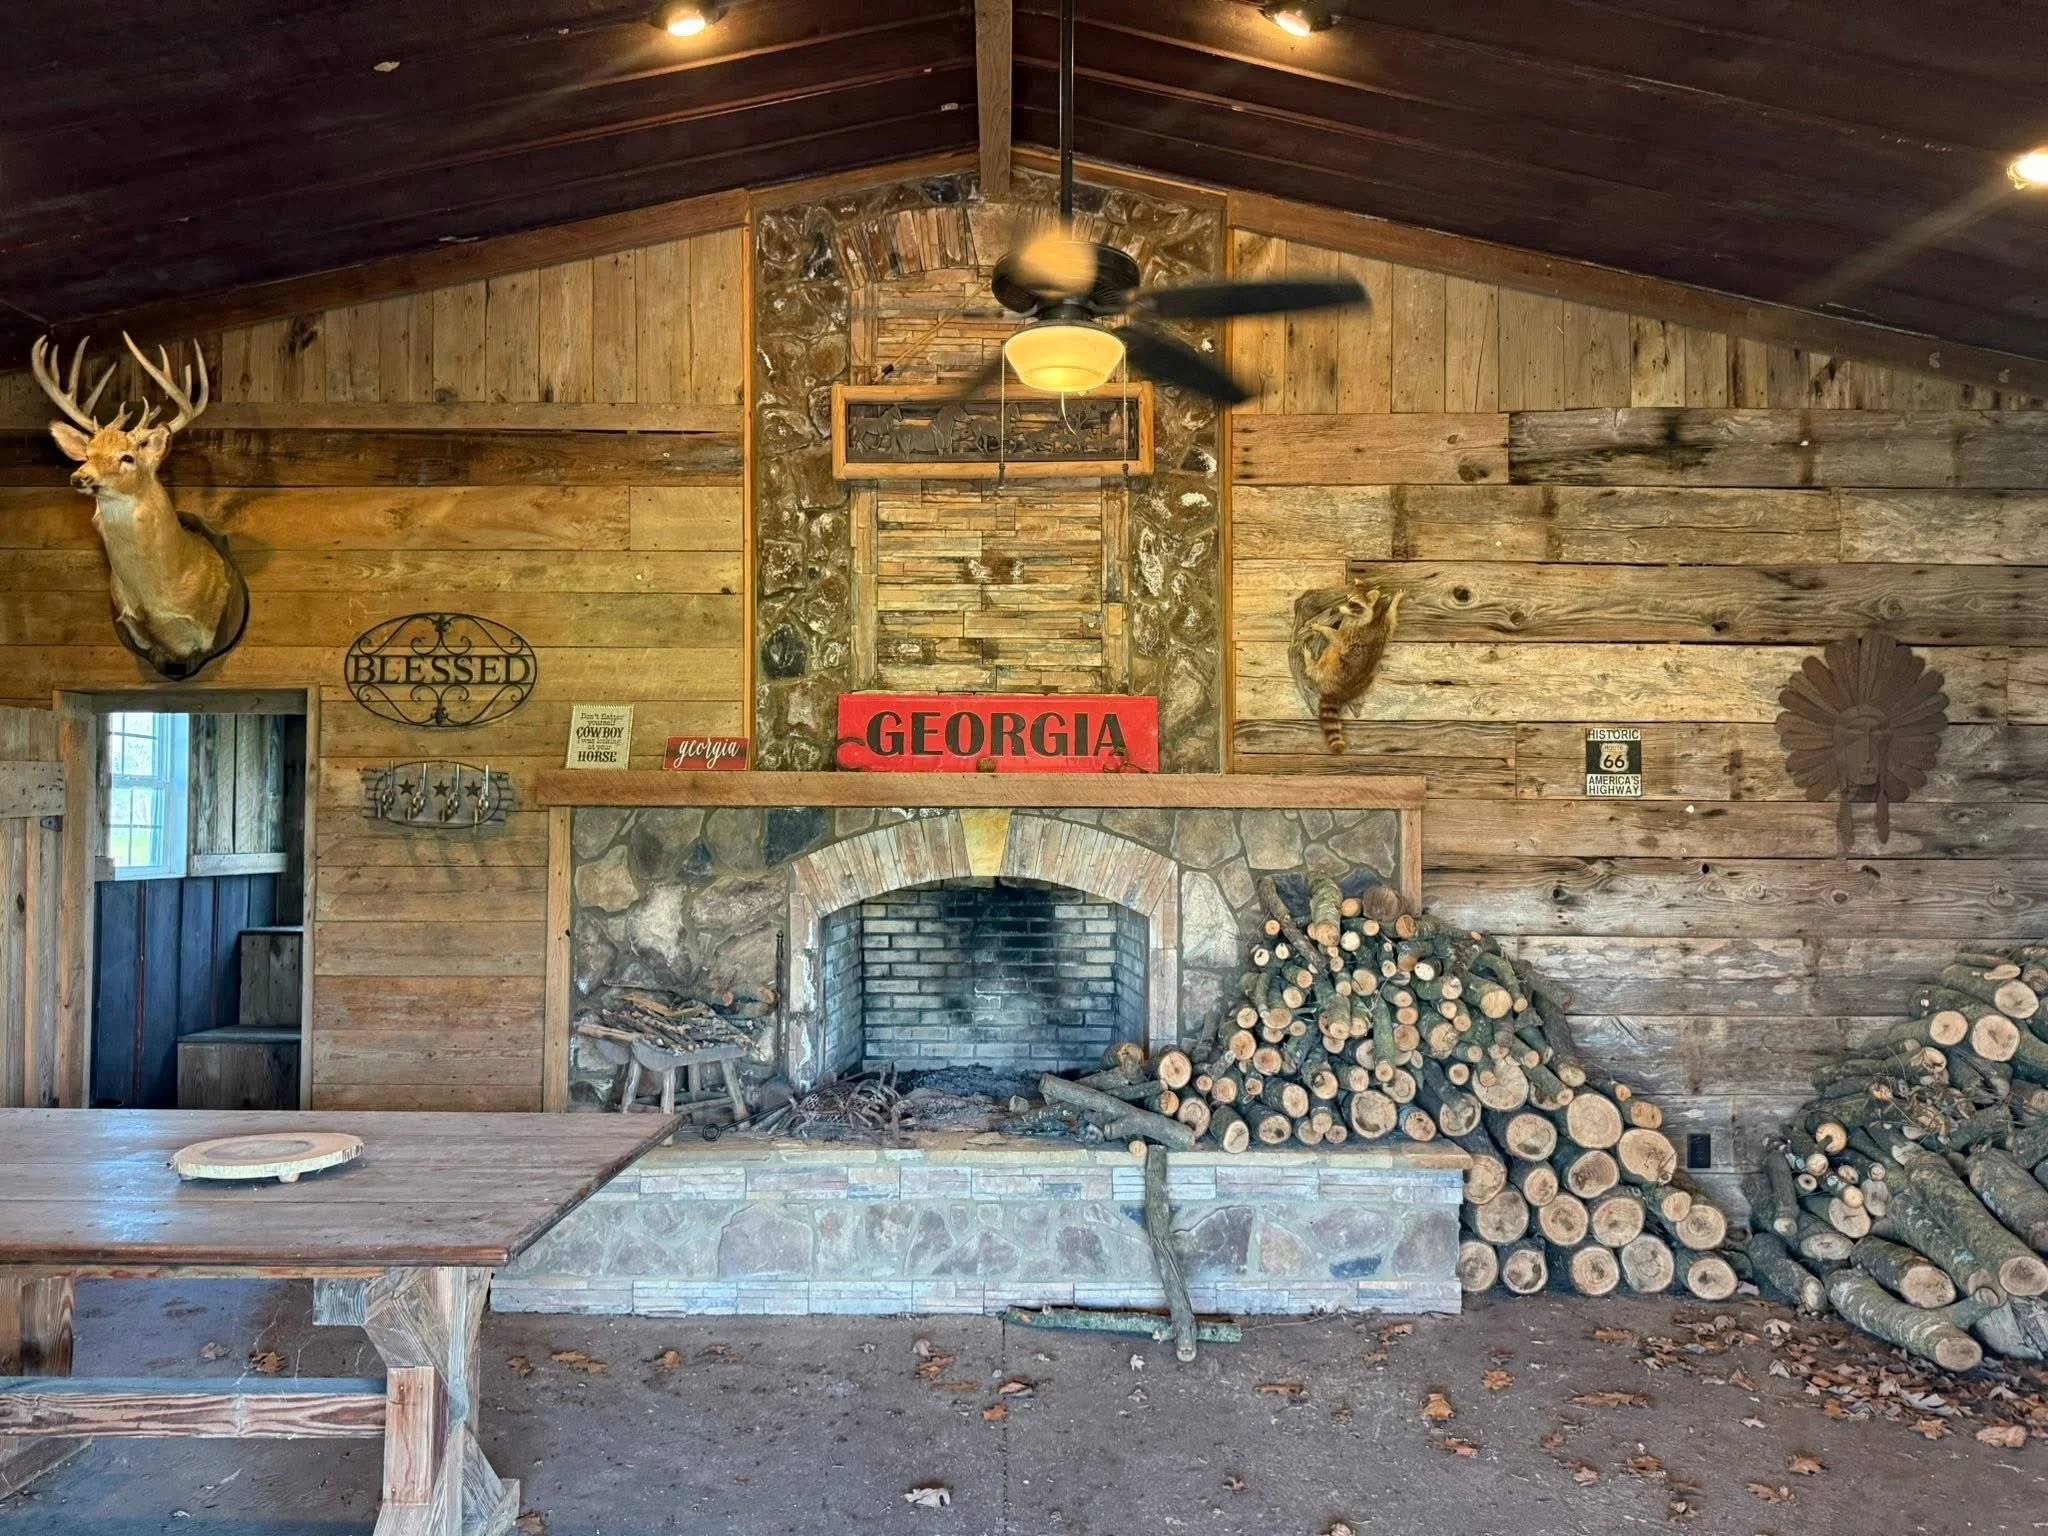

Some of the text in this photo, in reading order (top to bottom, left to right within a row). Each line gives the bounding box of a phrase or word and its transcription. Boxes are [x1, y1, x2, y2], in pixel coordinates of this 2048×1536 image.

[352, 655, 530, 684] BLESSED
[576, 726, 625, 738] COWBOY
[866, 711, 1128, 757] GEORGIA
[1588, 729, 1639, 739] HISTORIC
[577, 751, 617, 762] HORSE
[673, 737, 740, 769] georgia
[1603, 755, 1625, 769] 66
[1588, 776, 1639, 785] AMERICA'S
[1588, 785, 1639, 794] HIGHWAY
